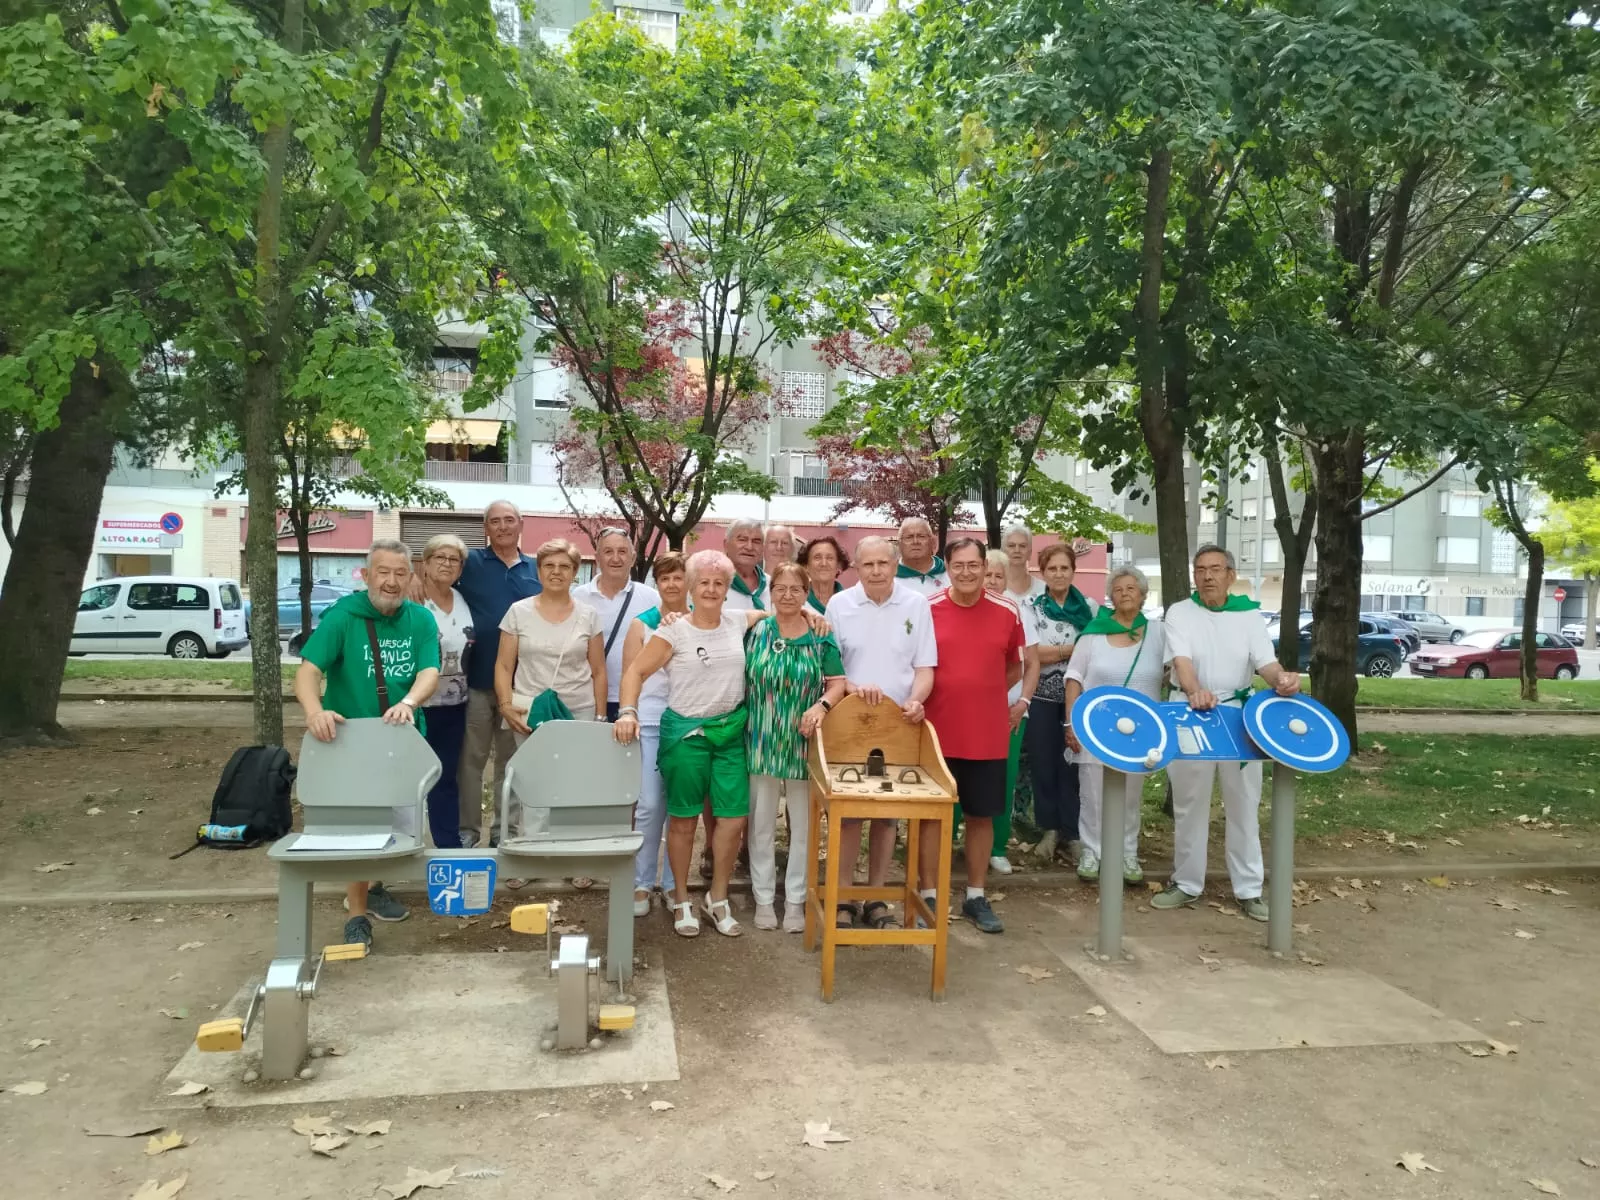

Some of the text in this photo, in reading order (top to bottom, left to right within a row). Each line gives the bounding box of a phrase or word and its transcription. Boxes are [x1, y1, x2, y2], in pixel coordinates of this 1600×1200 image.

[101, 535, 161, 543] ALTOARAGO
[1367, 580, 1413, 593] Solana
[367, 662, 416, 678] RNZO!
